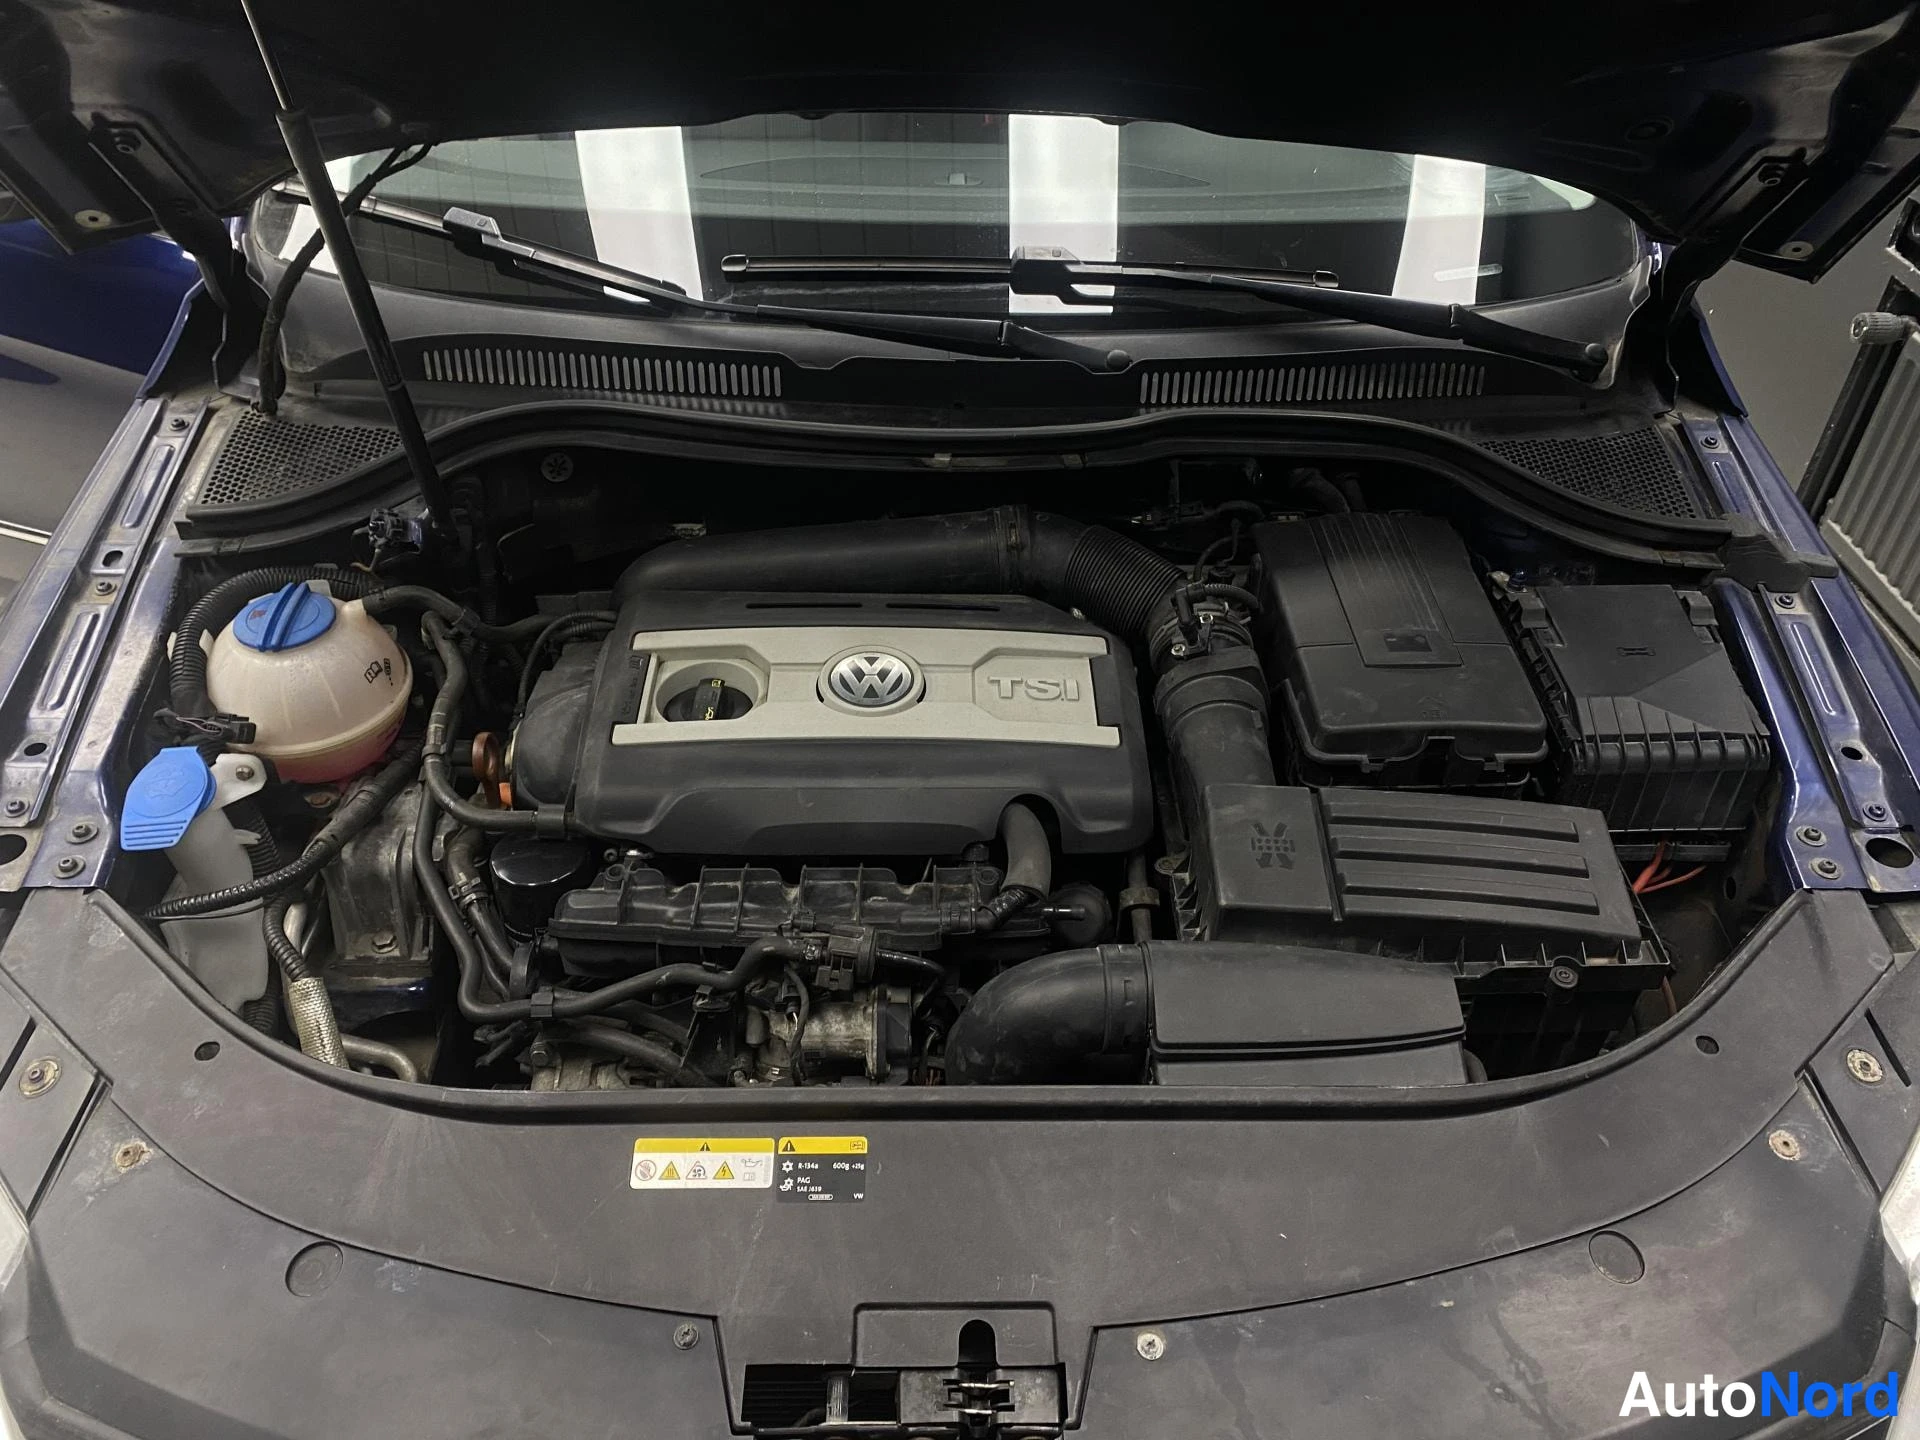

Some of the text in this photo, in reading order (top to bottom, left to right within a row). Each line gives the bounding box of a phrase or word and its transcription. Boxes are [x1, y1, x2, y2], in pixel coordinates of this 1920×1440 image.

[829, 651, 914, 707] VW
[987, 676, 1080, 702] TSI
[798, 1162, 819, 1170] R-134a
[832, 1162, 850, 1171] 600g
[797, 1176, 811, 1184] PAG
